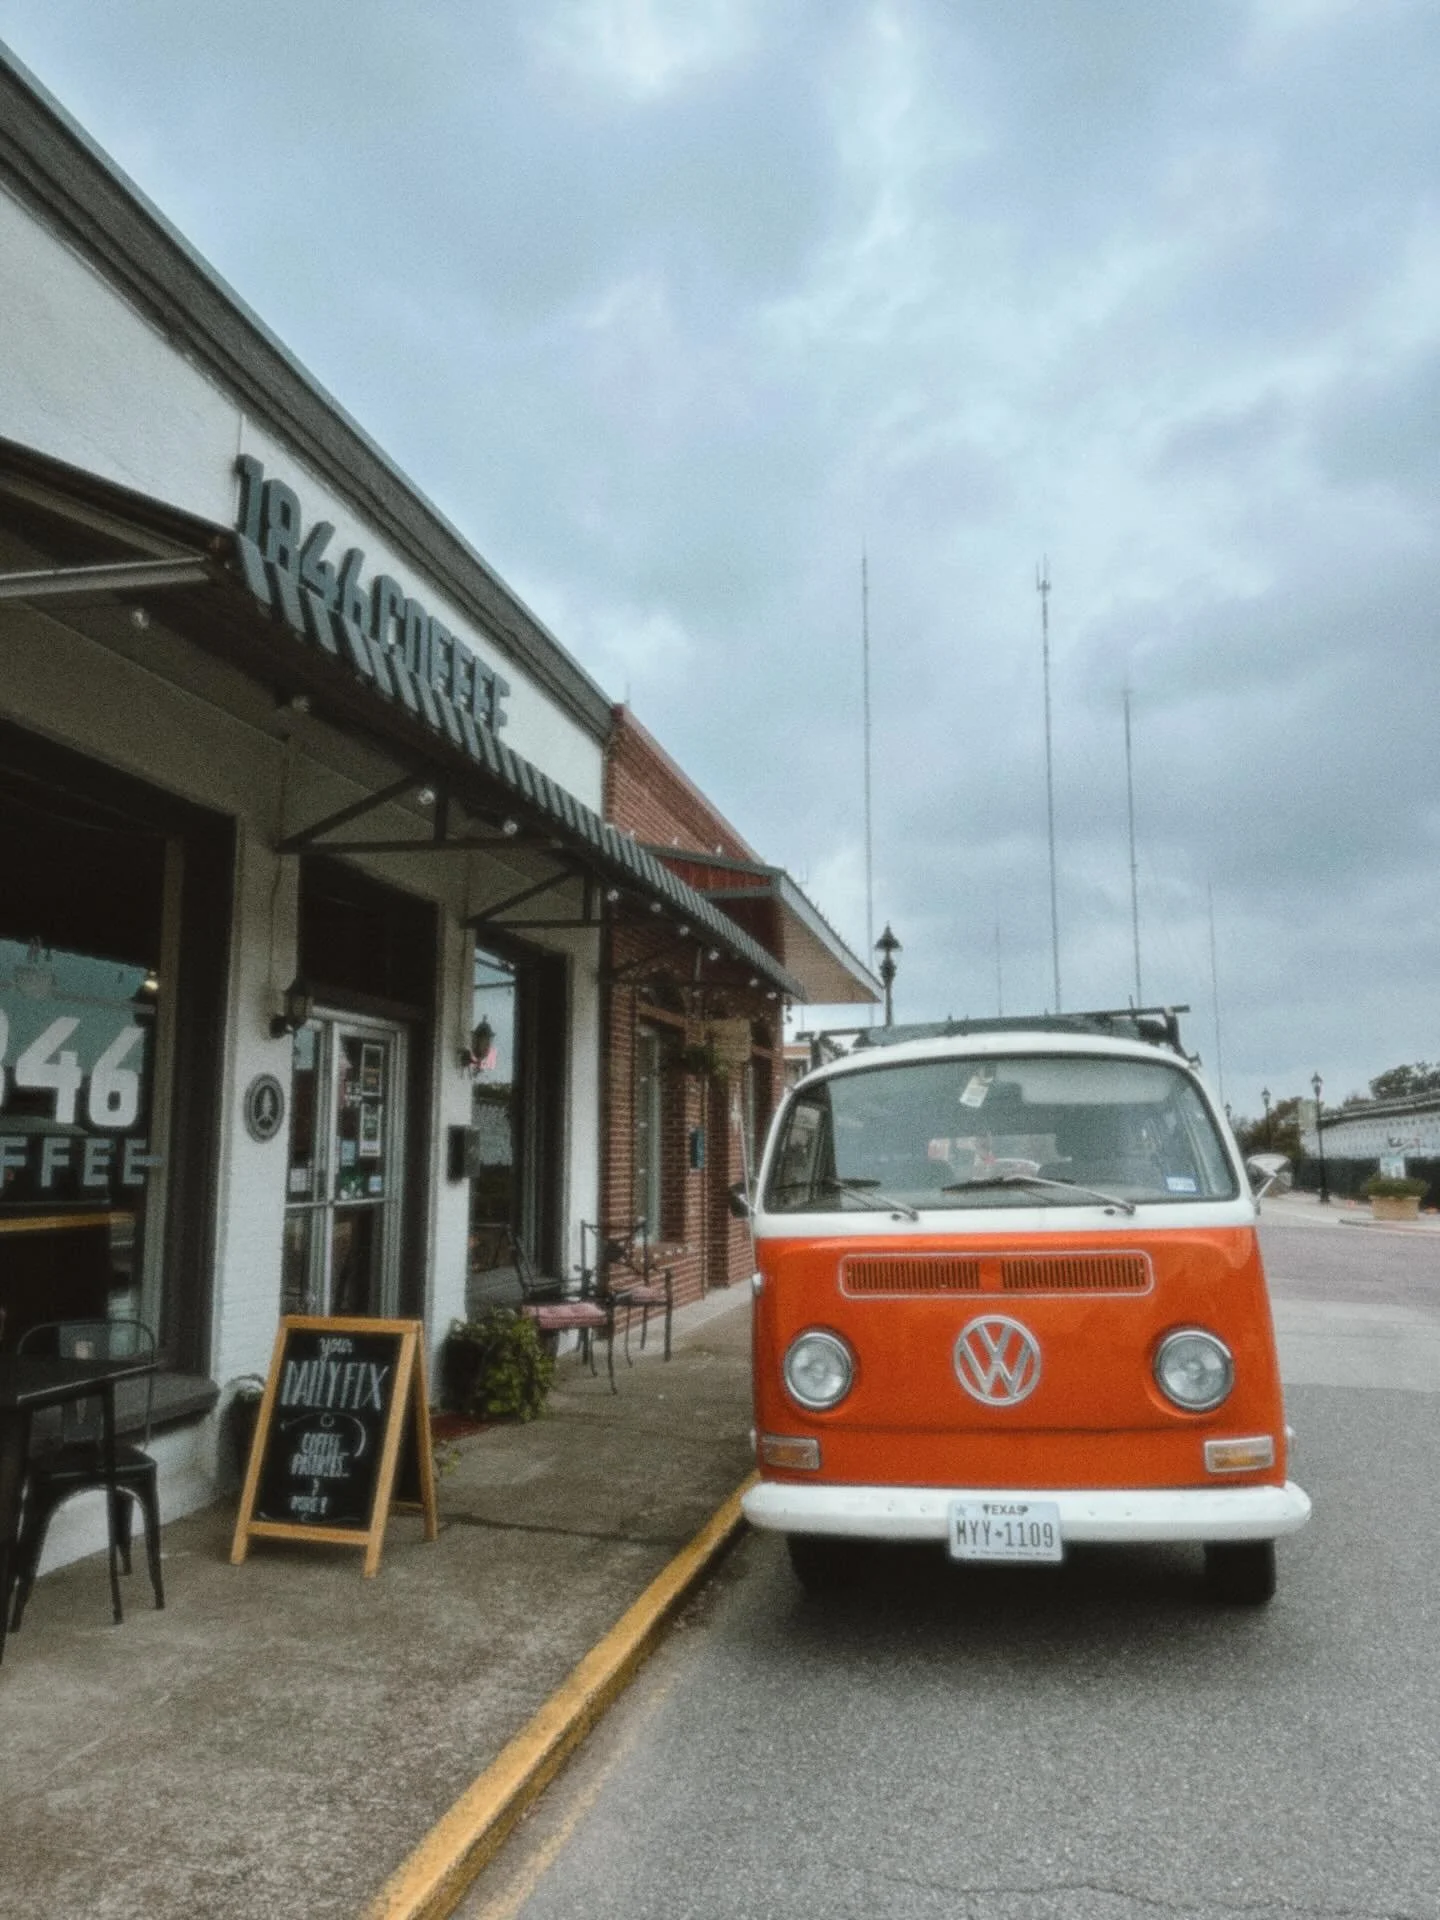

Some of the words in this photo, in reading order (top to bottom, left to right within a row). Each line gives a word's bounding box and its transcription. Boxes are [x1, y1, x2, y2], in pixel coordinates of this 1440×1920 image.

[370, 574, 511, 738] COFFEE
[0, 1008, 145, 1127] 46
[281, 1360, 342, 1408] DAILY
[340, 1362, 389, 1411] FIX
[982, 1504, 1029, 1515] TEXAS
